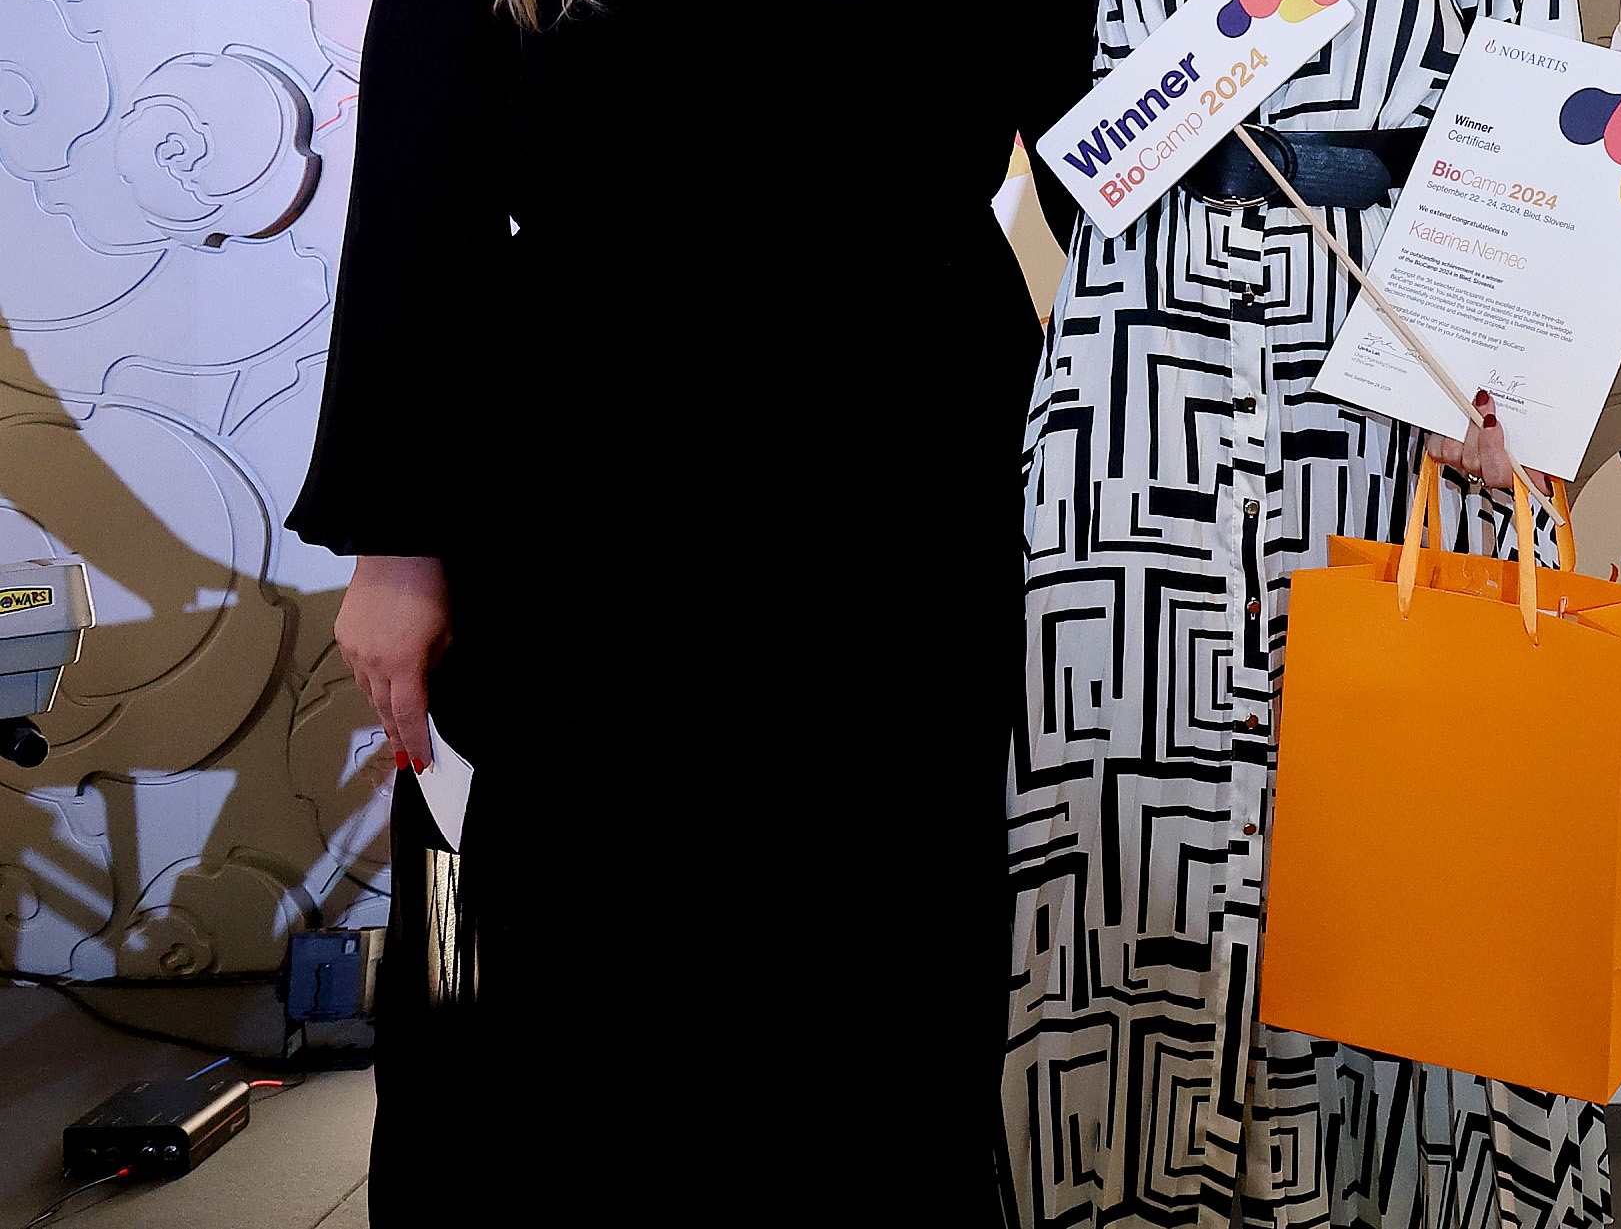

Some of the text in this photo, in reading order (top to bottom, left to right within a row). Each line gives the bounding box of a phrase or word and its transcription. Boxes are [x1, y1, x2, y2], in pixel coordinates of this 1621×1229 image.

[1498, 44, 1569, 73] NOVARTIS
[1063, 52, 1201, 178] Winner
[1099, 47, 1269, 208] BioCamp 2024
[1452, 113, 1494, 133] Winner
[1446, 129, 1501, 153] Certificate
[1430, 159, 1560, 211] BioCamp 2024
[1417, 204, 1428, 212] We
[1429, 208, 1451, 219] extend
[1451, 215, 1500, 234] congratulations
[1426, 180, 1468, 198] September
[1468, 193, 1480, 202] 22
[1486, 198, 1498, 209] 24,
[1499, 202, 1520, 215] 2024,
[1522, 209, 1541, 221] Bled,
[1542, 215, 1575, 230] Slovenia
[1408, 219, 1528, 270] Katarina Nemec
[1409, 251, 1440, 265] outstanding
[1441, 261, 1474, 274] achievement
[1485, 275, 1503, 283] winner
[1413, 259, 1437, 272] BioCamp
[1438, 267, 1453, 275] 2024
[1458, 273, 1471, 282] Bled,
[1472, 278, 1494, 289] Slovenia.
[11, 590, 48, 606] WARS
